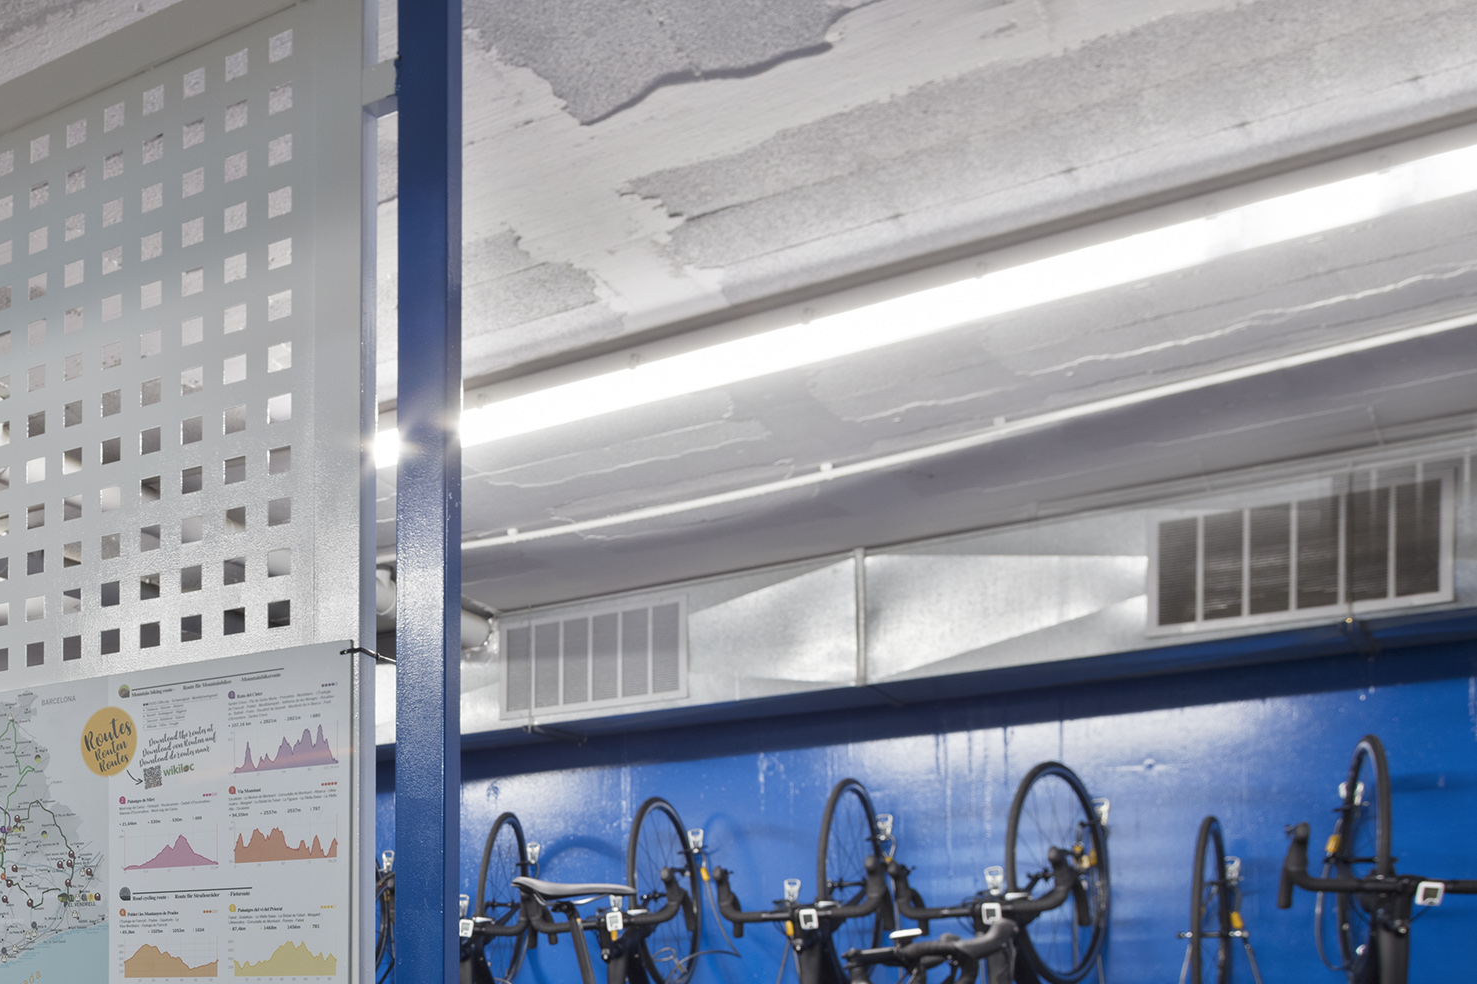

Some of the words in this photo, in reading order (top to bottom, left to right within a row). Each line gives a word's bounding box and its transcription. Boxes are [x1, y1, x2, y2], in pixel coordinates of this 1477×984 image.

[242, 673, 281, 682] Mountainbikeroute
[41, 695, 76, 706] BARCELONA
[84, 718, 132, 752] Routes
[149, 730, 178, 747] Download
[179, 730, 188, 740] the
[189, 726, 206, 737] routes
[206, 723, 213, 733] at
[95, 740, 128, 762] Routen
[142, 742, 171, 757] Download
[184, 735, 204, 747] Routen
[99, 752, 129, 772] Routes
[139, 752, 168, 767] Download
[163, 763, 194, 776] wikiloc
